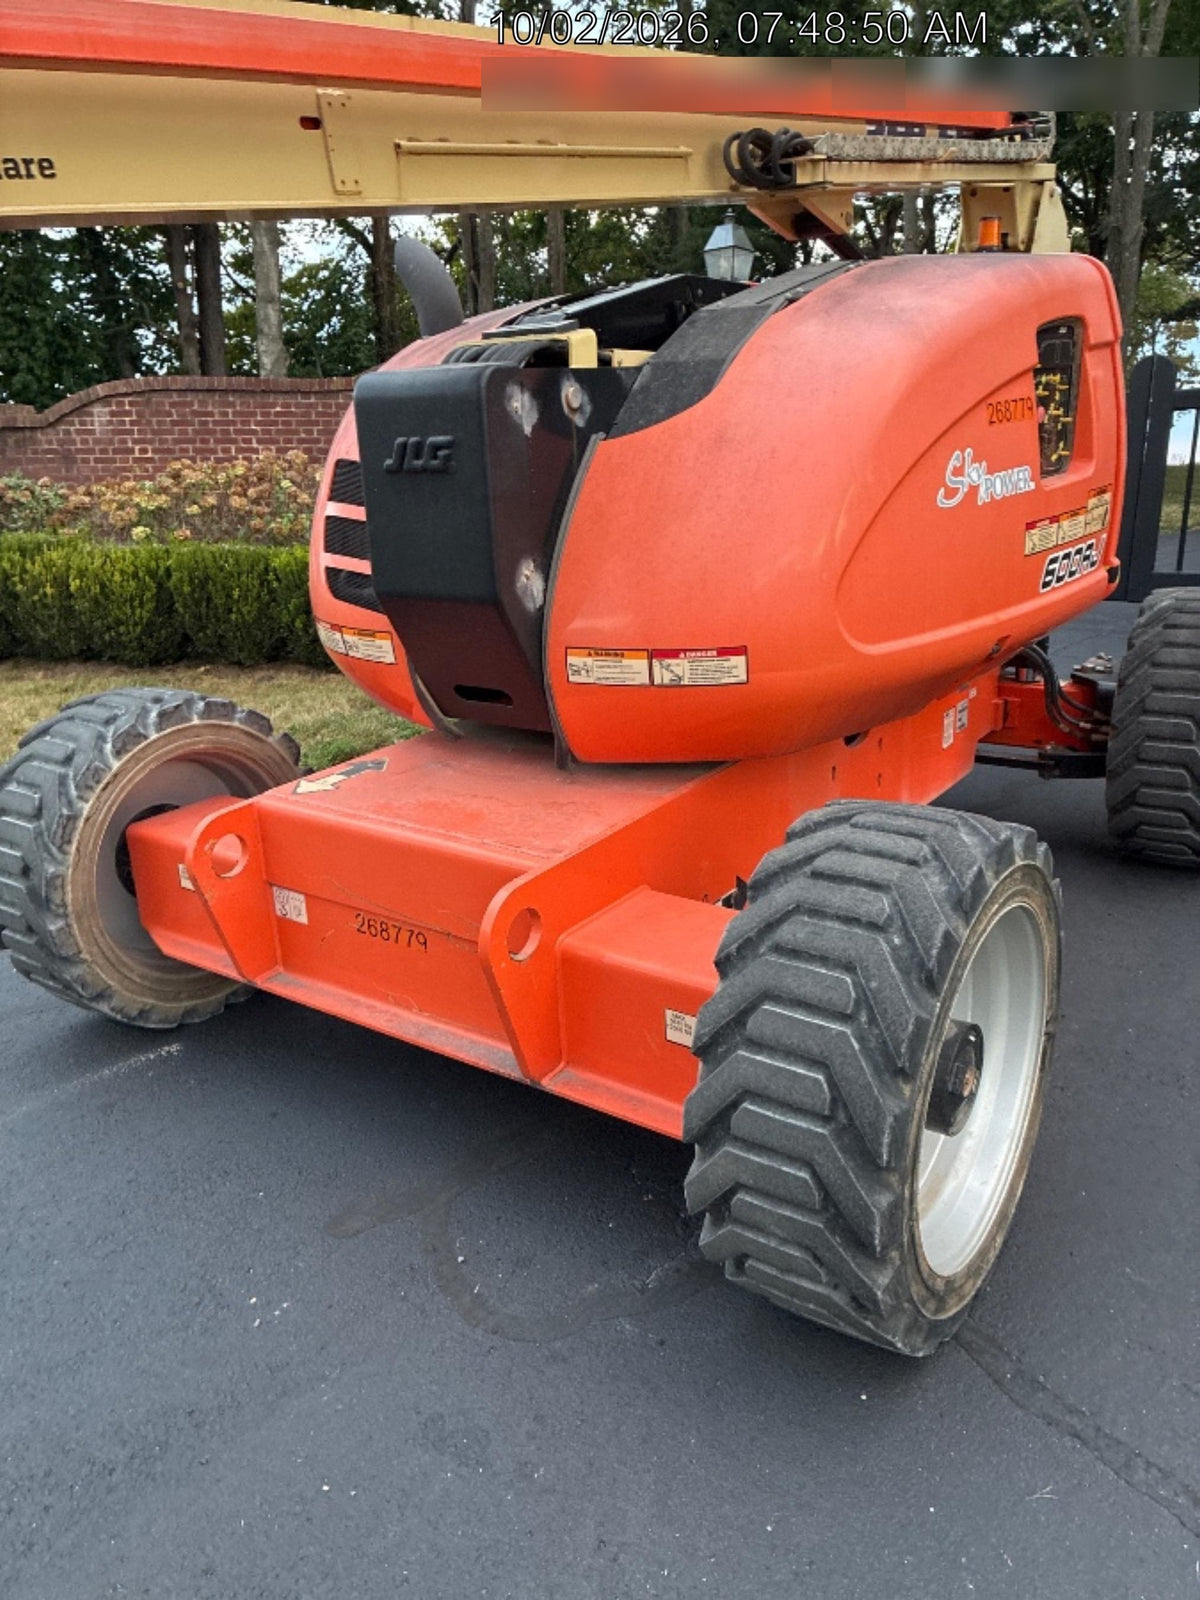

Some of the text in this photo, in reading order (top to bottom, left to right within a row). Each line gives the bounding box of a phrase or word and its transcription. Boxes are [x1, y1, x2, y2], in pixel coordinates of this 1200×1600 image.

[0, 157, 57, 180] are
[986, 396, 1034, 425] 268779
[383, 435, 456, 474] JLG
[354, 913, 428, 953] 268779
